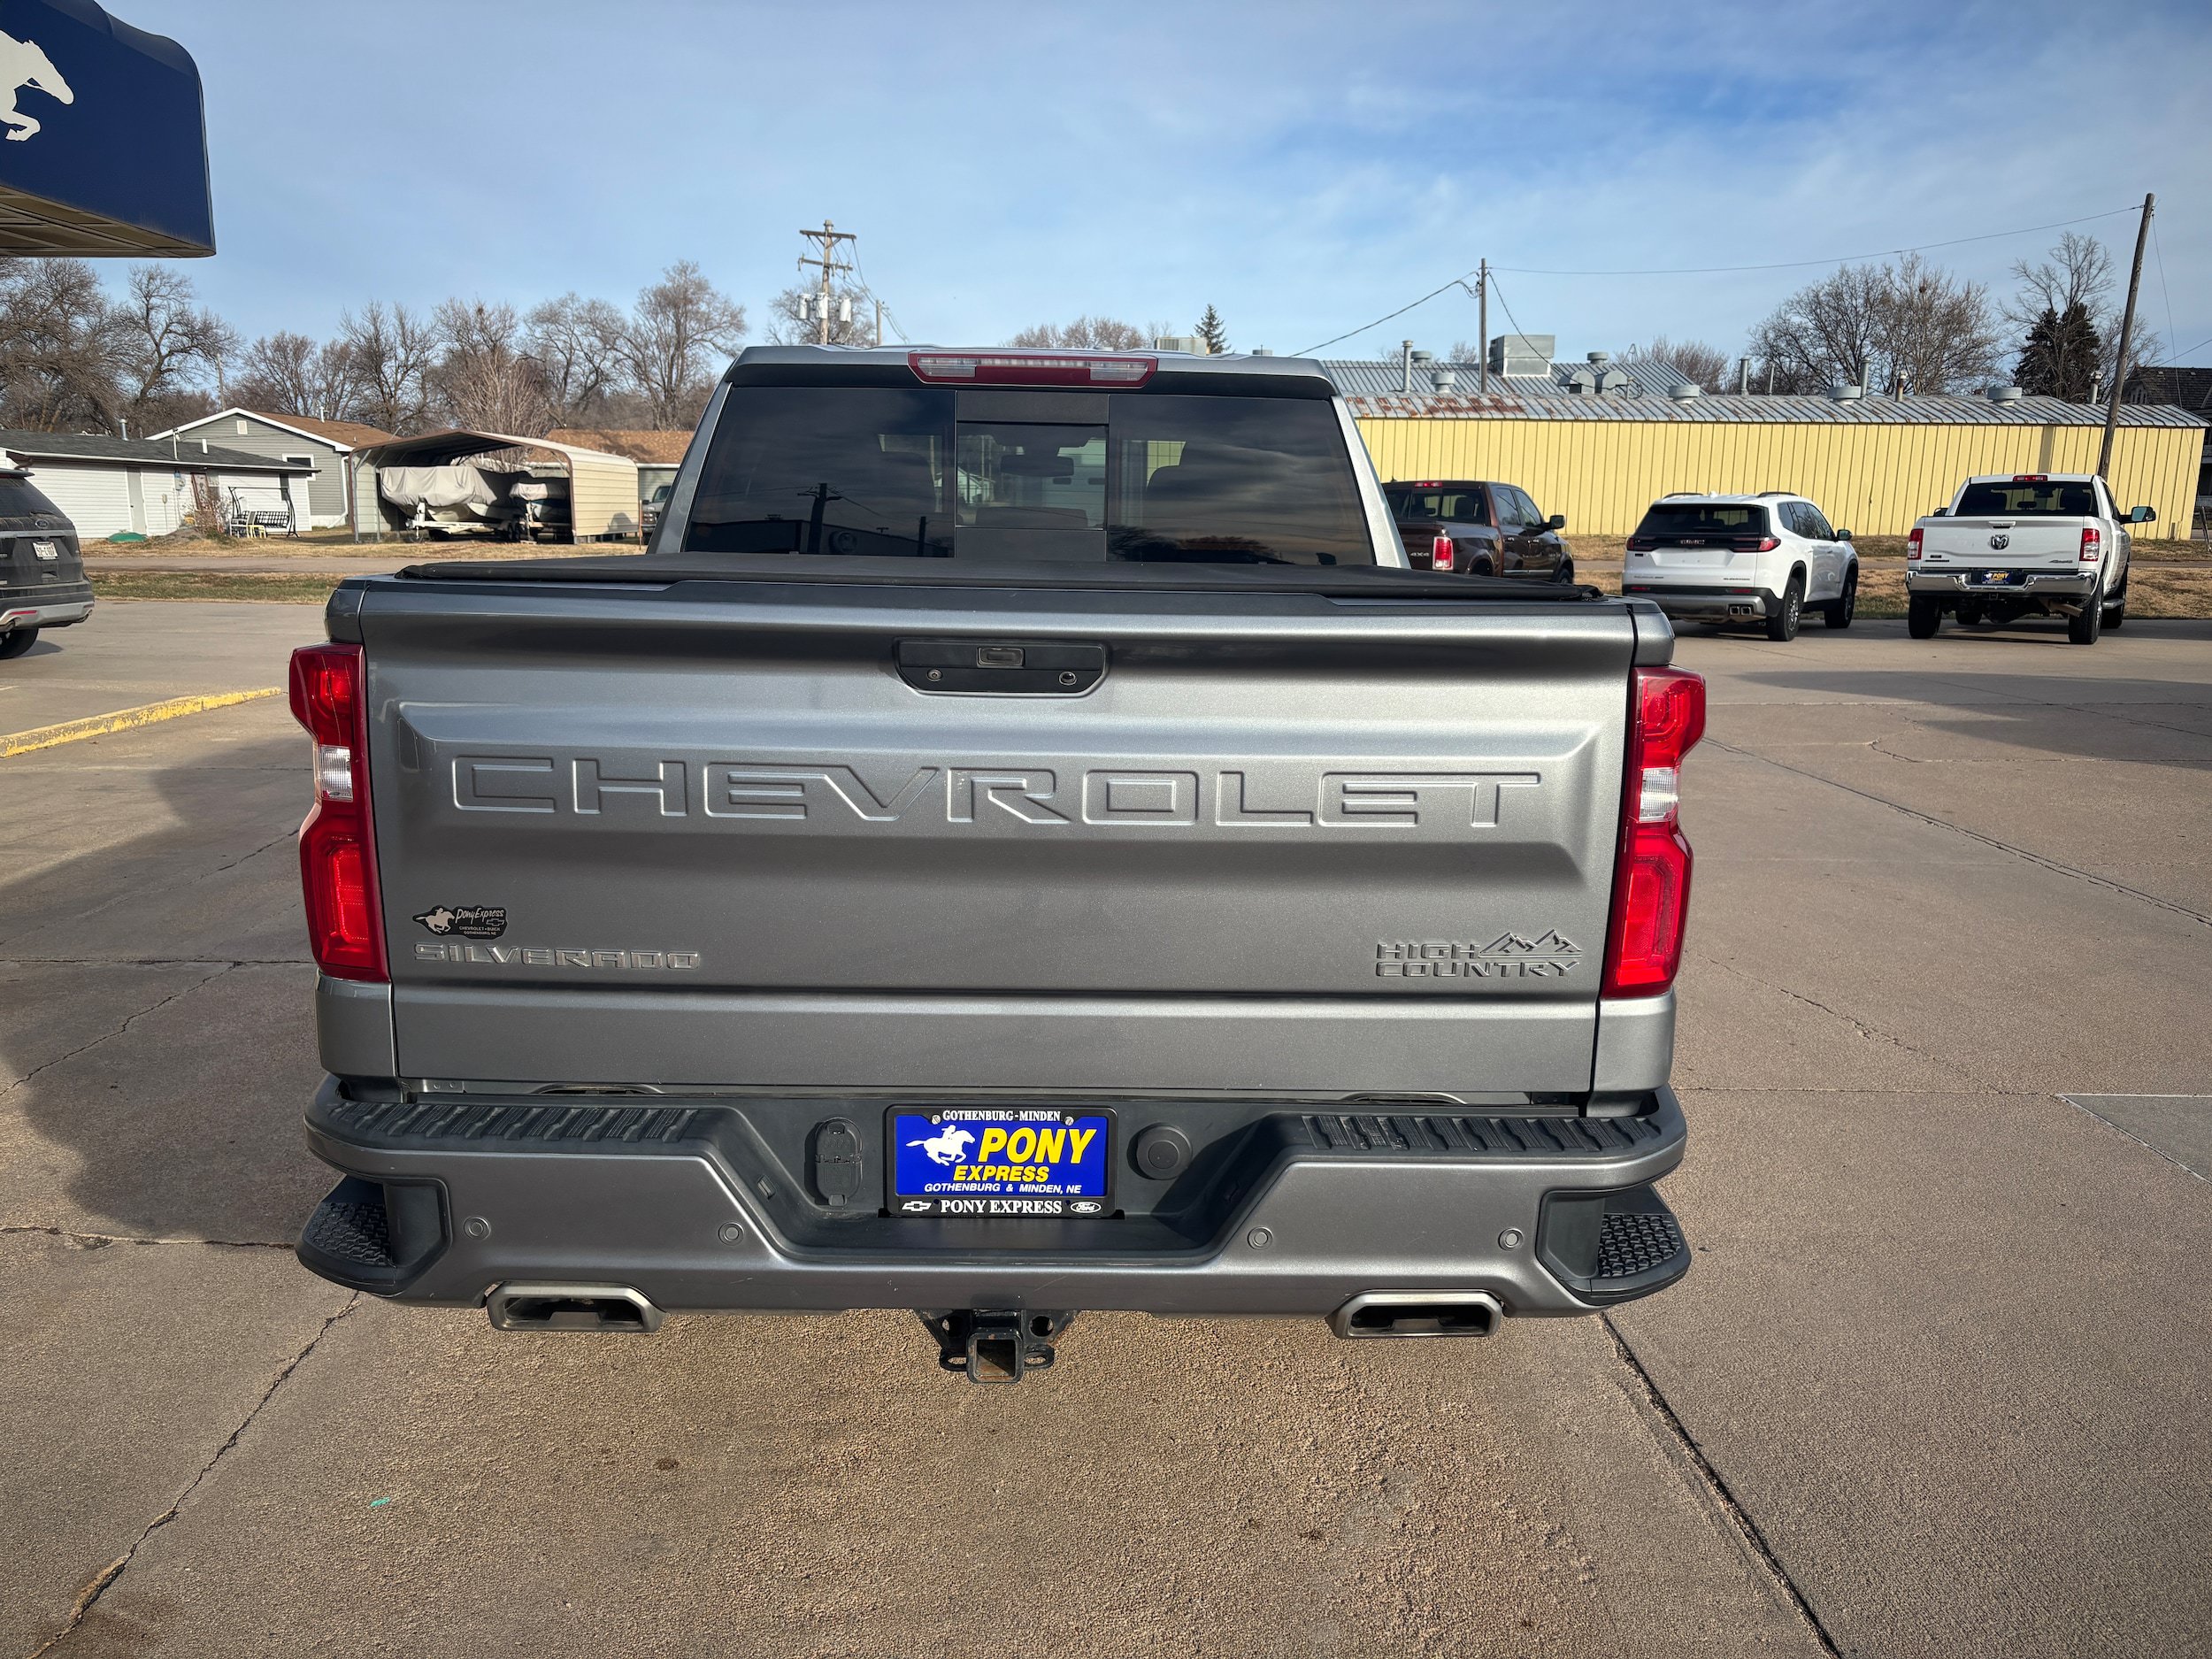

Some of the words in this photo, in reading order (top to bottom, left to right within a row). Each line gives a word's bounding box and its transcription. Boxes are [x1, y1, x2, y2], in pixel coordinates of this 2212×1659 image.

[452, 756, 1540, 826] CHEVROLET
[413, 942, 701, 970] SILVERADO
[1377, 942, 1480, 959] HIGH
[1375, 961, 1580, 978] COUNTRY
[978, 1127, 1098, 1164] PONY
[953, 1165, 1050, 1183] EXPRESS
[924, 1183, 1001, 1193] GOTHENBURG
[1018, 1184, 1064, 1194] MINDEN,
[1065, 1185, 1082, 1194] NE
[940, 1200, 987, 1214] PONY
[989, 1200, 1063, 1214] EXPRESS
